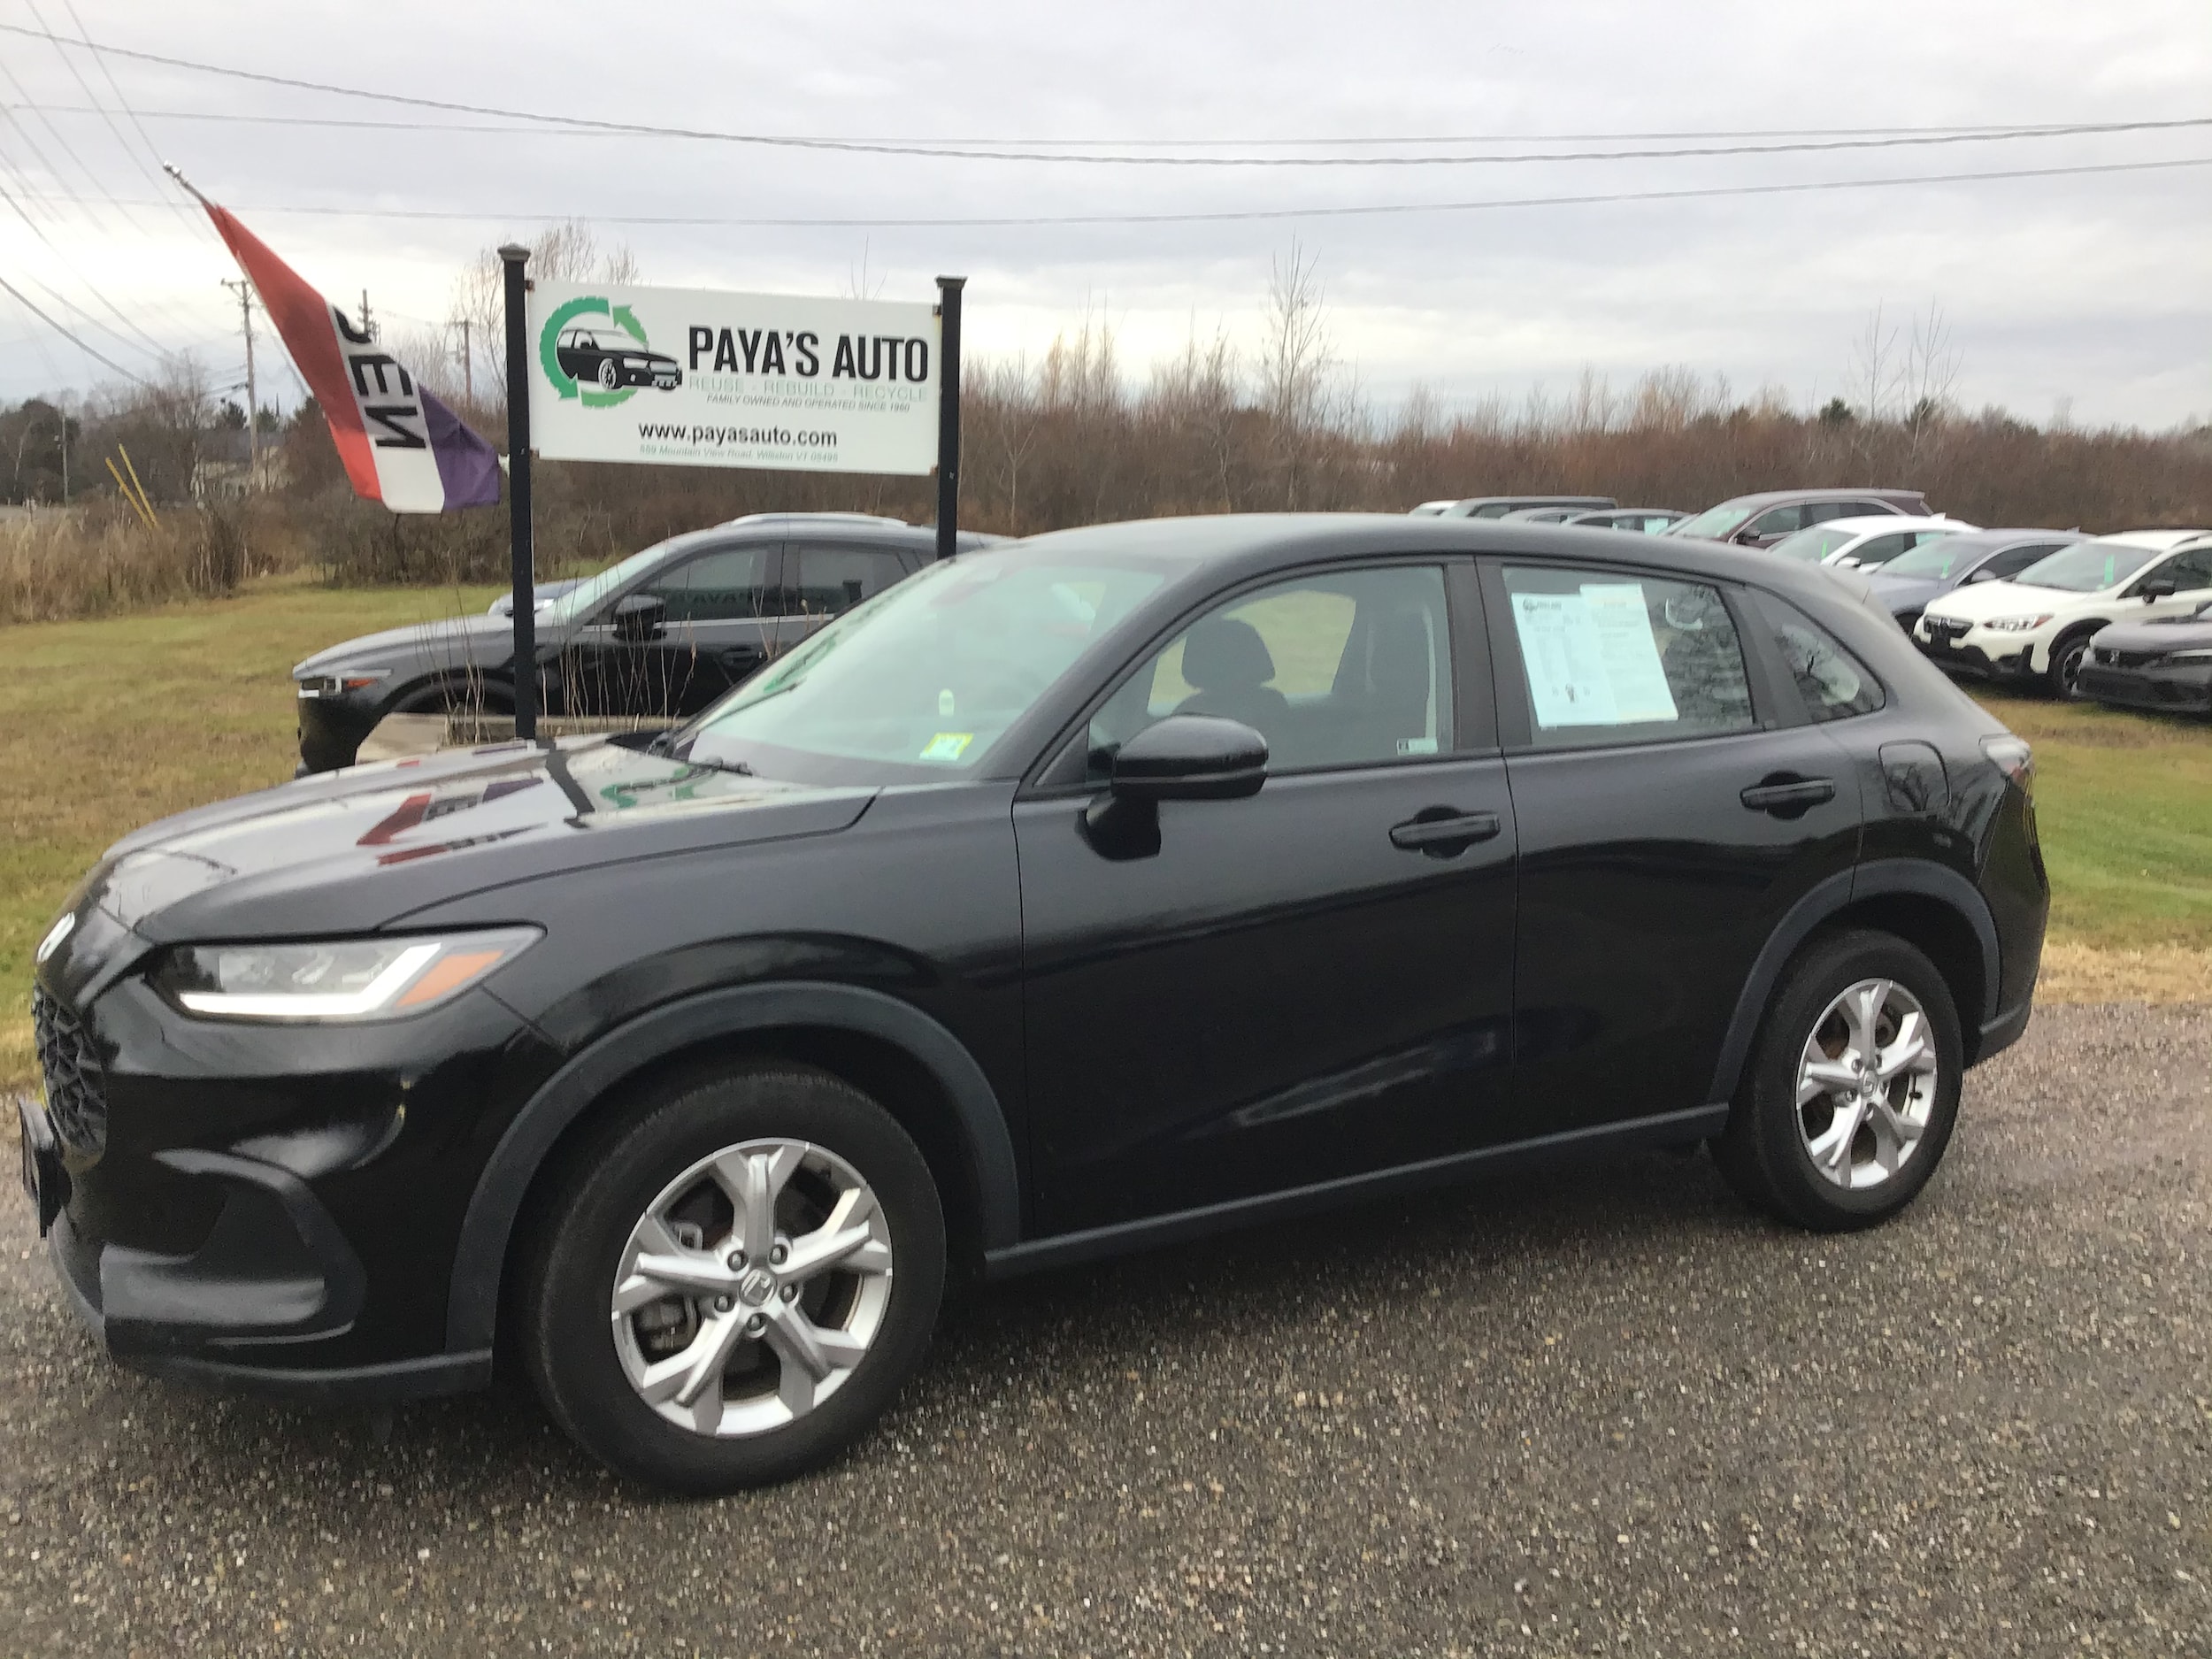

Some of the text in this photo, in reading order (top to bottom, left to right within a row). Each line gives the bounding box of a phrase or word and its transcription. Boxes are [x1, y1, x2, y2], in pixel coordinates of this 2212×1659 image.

[688, 326, 928, 382] PAYA'S AUTO
[689, 375, 927, 402] REUSE REBUILD RECYCLE
[706, 393, 741, 405] FAMILY
[743, 396, 780, 407] OWNED
[781, 397, 803, 408] AND
[804, 398, 856, 411] OPERATED
[857, 401, 887, 411] SINCE
[638, 422, 838, 448] www.payasauto.com
[658, 445, 701, 457] Mountain
[703, 447, 725, 458] View
[757, 449, 793, 461] Williston
[795, 451, 808, 461] VT
